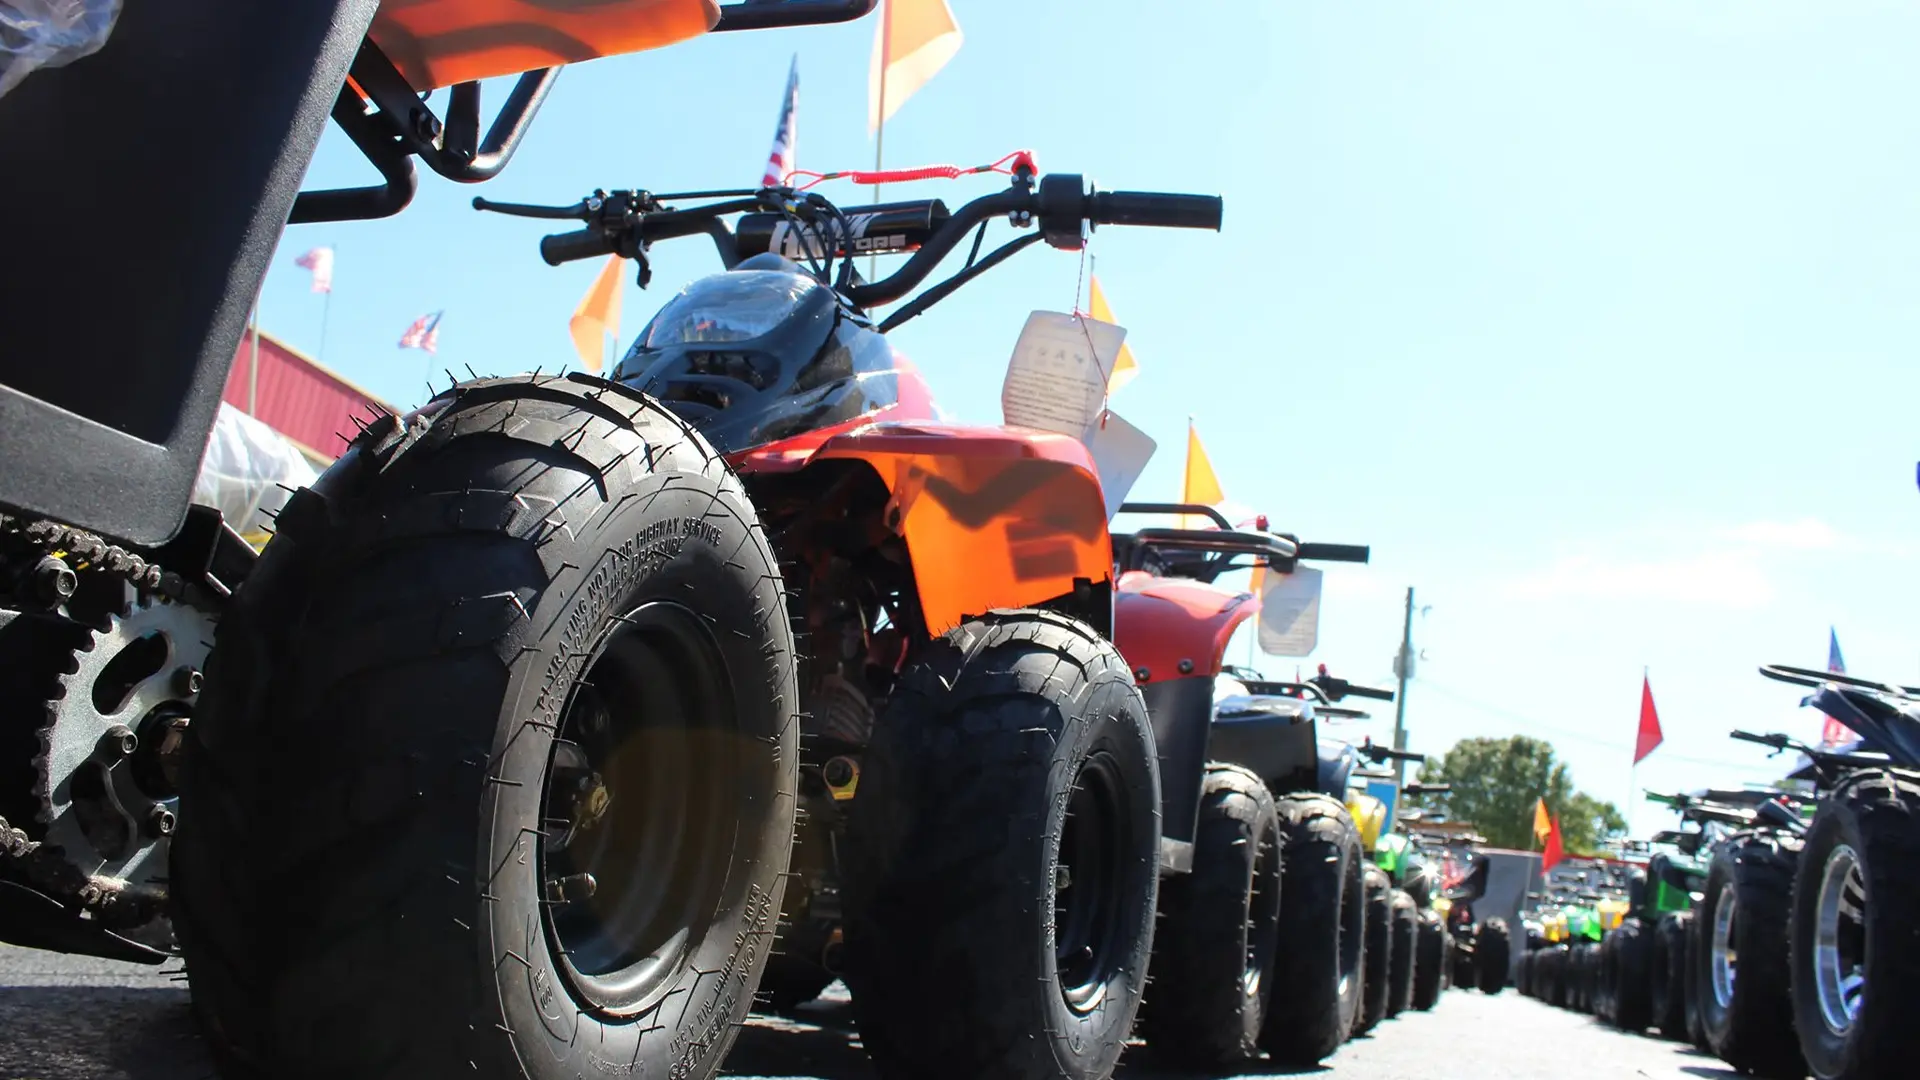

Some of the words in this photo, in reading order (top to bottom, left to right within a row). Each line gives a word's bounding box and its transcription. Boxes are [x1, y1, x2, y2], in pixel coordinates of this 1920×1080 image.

[587, 563, 609, 599] NOT
[612, 537, 634, 566] FOR
[636, 516, 680, 549] HIGHWAY
[682, 516, 722, 547] SERVICE
